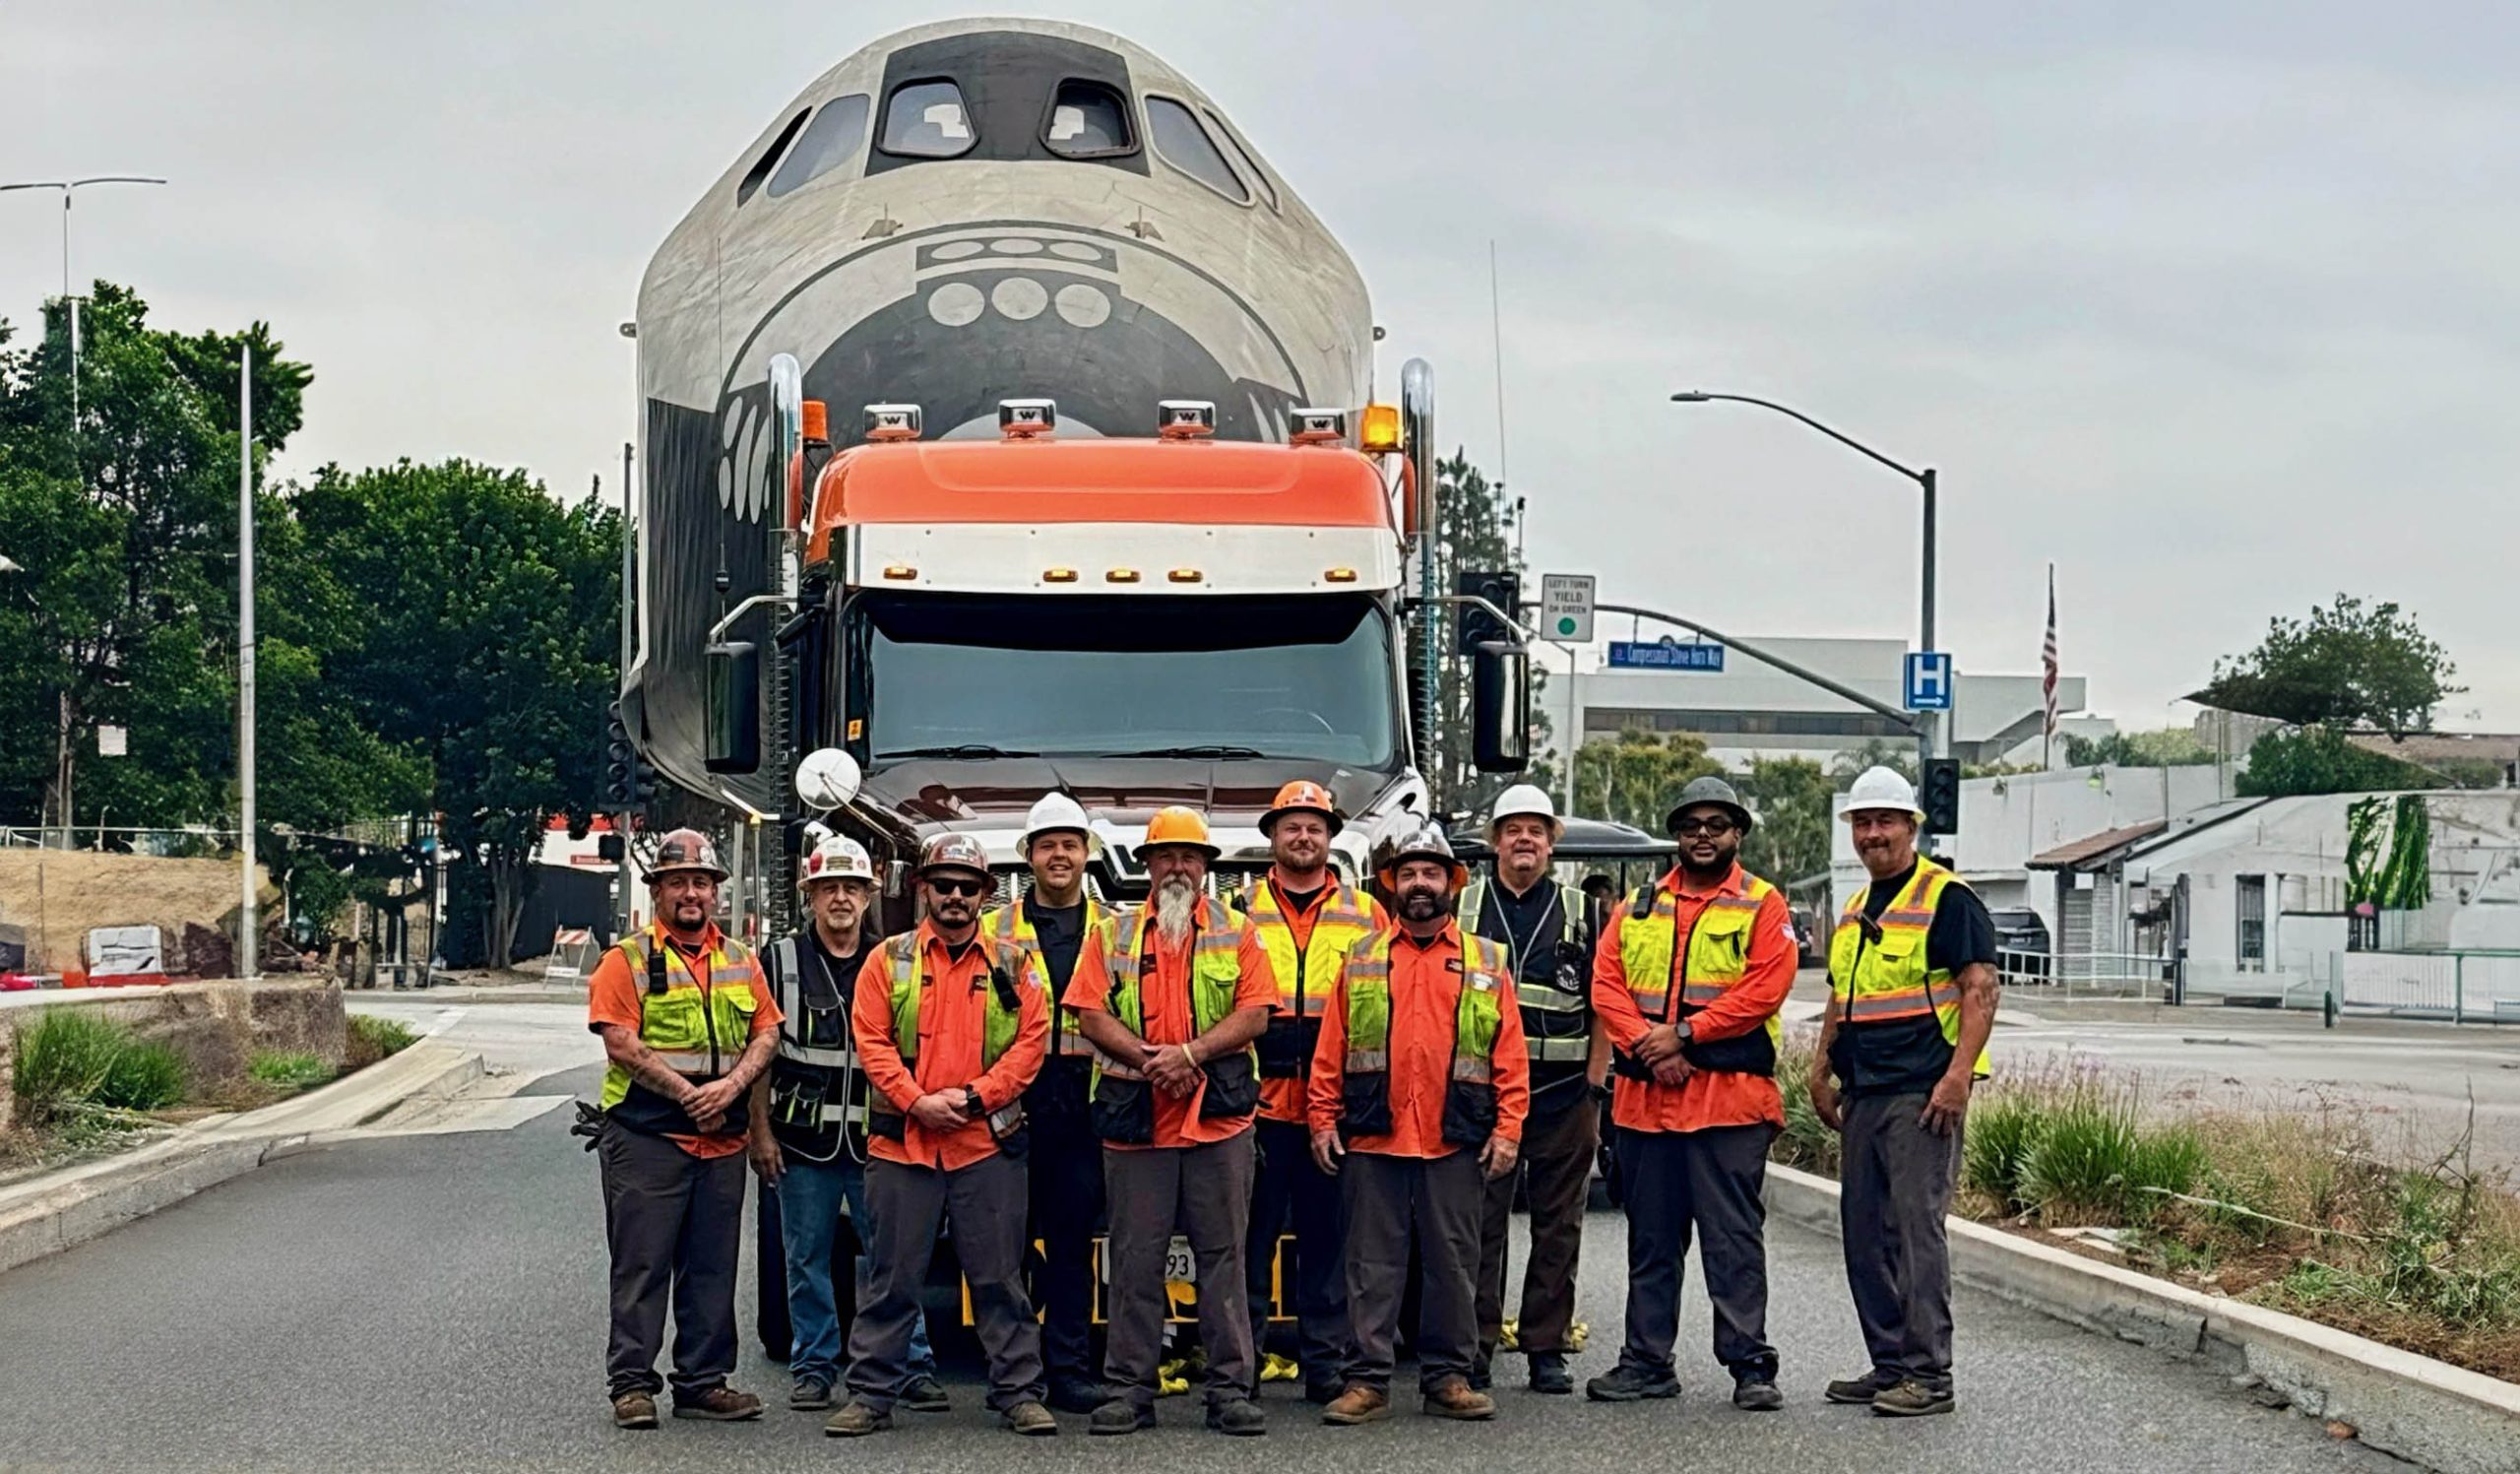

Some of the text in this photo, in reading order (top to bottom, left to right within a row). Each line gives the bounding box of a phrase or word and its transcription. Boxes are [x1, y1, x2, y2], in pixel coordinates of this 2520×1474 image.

[1569, 580, 1589, 589] TURN
[1554, 592, 1583, 603] YIELD
[1562, 605, 1587, 614] GREEN
[1627, 644, 1670, 666] Congressman
[1670, 646, 1689, 665] Steve
[1707, 648, 1721, 667] Way
[1914, 656, 1945, 695] H
